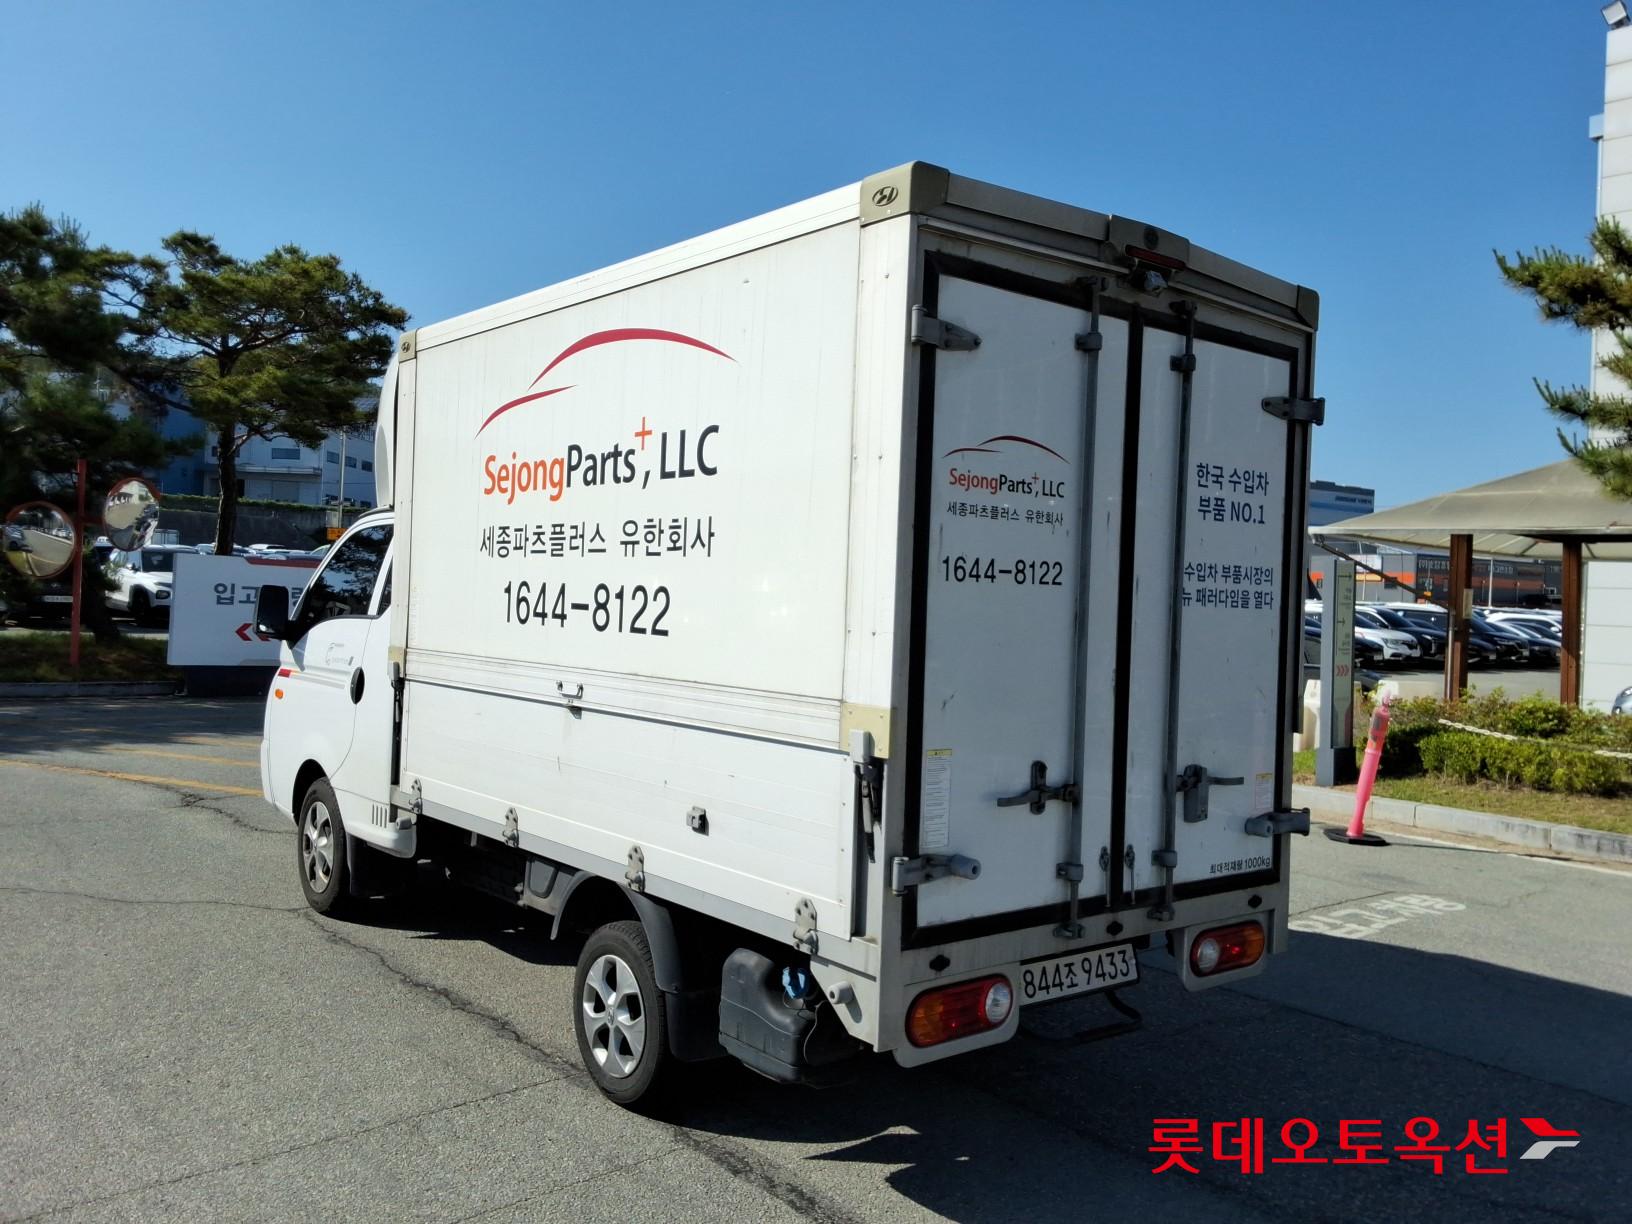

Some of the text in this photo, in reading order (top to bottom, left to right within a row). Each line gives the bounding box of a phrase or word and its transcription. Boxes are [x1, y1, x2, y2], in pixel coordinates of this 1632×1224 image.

[1196, 462, 1270, 497] 한국 수입차
[947, 501, 1064, 527] 세종파츠플러스 유한회사
[1198, 495, 1265, 525] 부품 NO.1
[479, 515, 715, 558] 세종파츠플러스 유한회사
[942, 555, 1063, 586] 1644-8122
[1183, 561, 1274, 587] 수입차 부품시장의
[503, 580, 671, 637] 1644-8122
[1182, 587, 1274, 610] 뉴 패러다임을 열다
[1244, 855, 1271, 871] 1000kg
[1023, 950, 1130, 998] 844조9433
